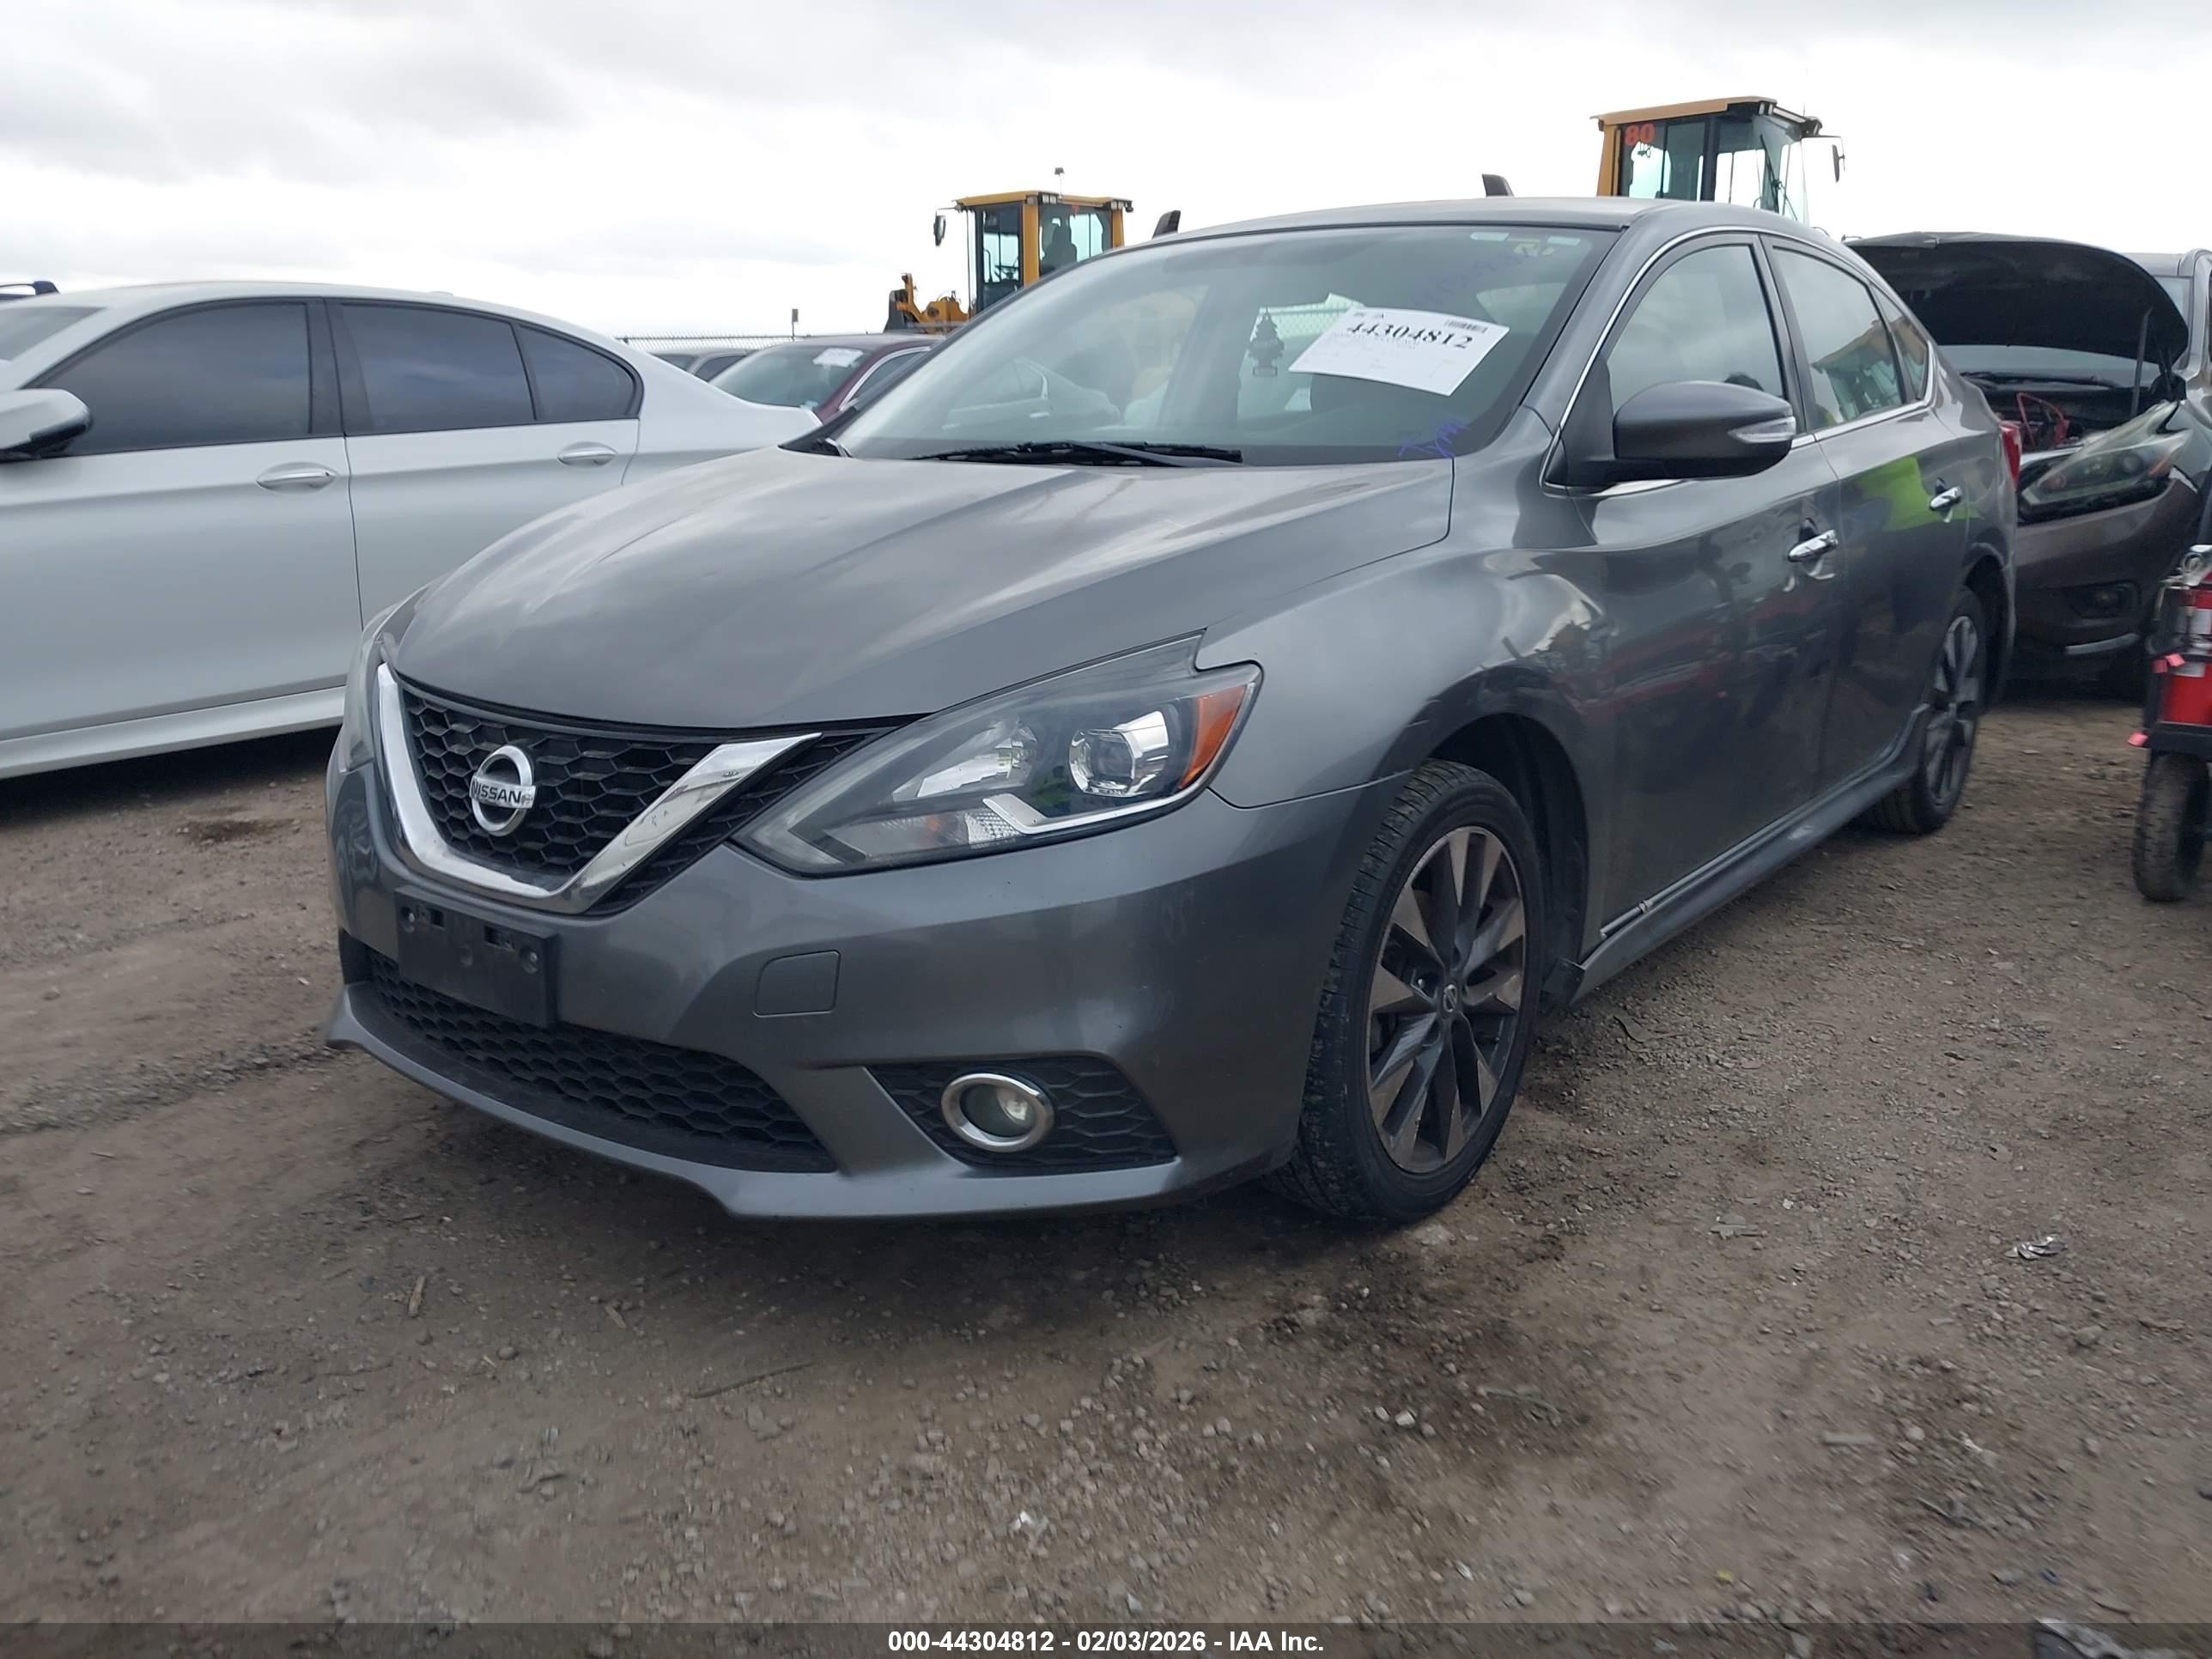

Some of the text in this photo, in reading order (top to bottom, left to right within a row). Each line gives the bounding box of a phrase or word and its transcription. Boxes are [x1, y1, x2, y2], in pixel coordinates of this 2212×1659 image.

[1626, 124, 1655, 146] 80
[1348, 322, 1474, 349] 44304812
[471, 780, 522, 803] NISSAN
